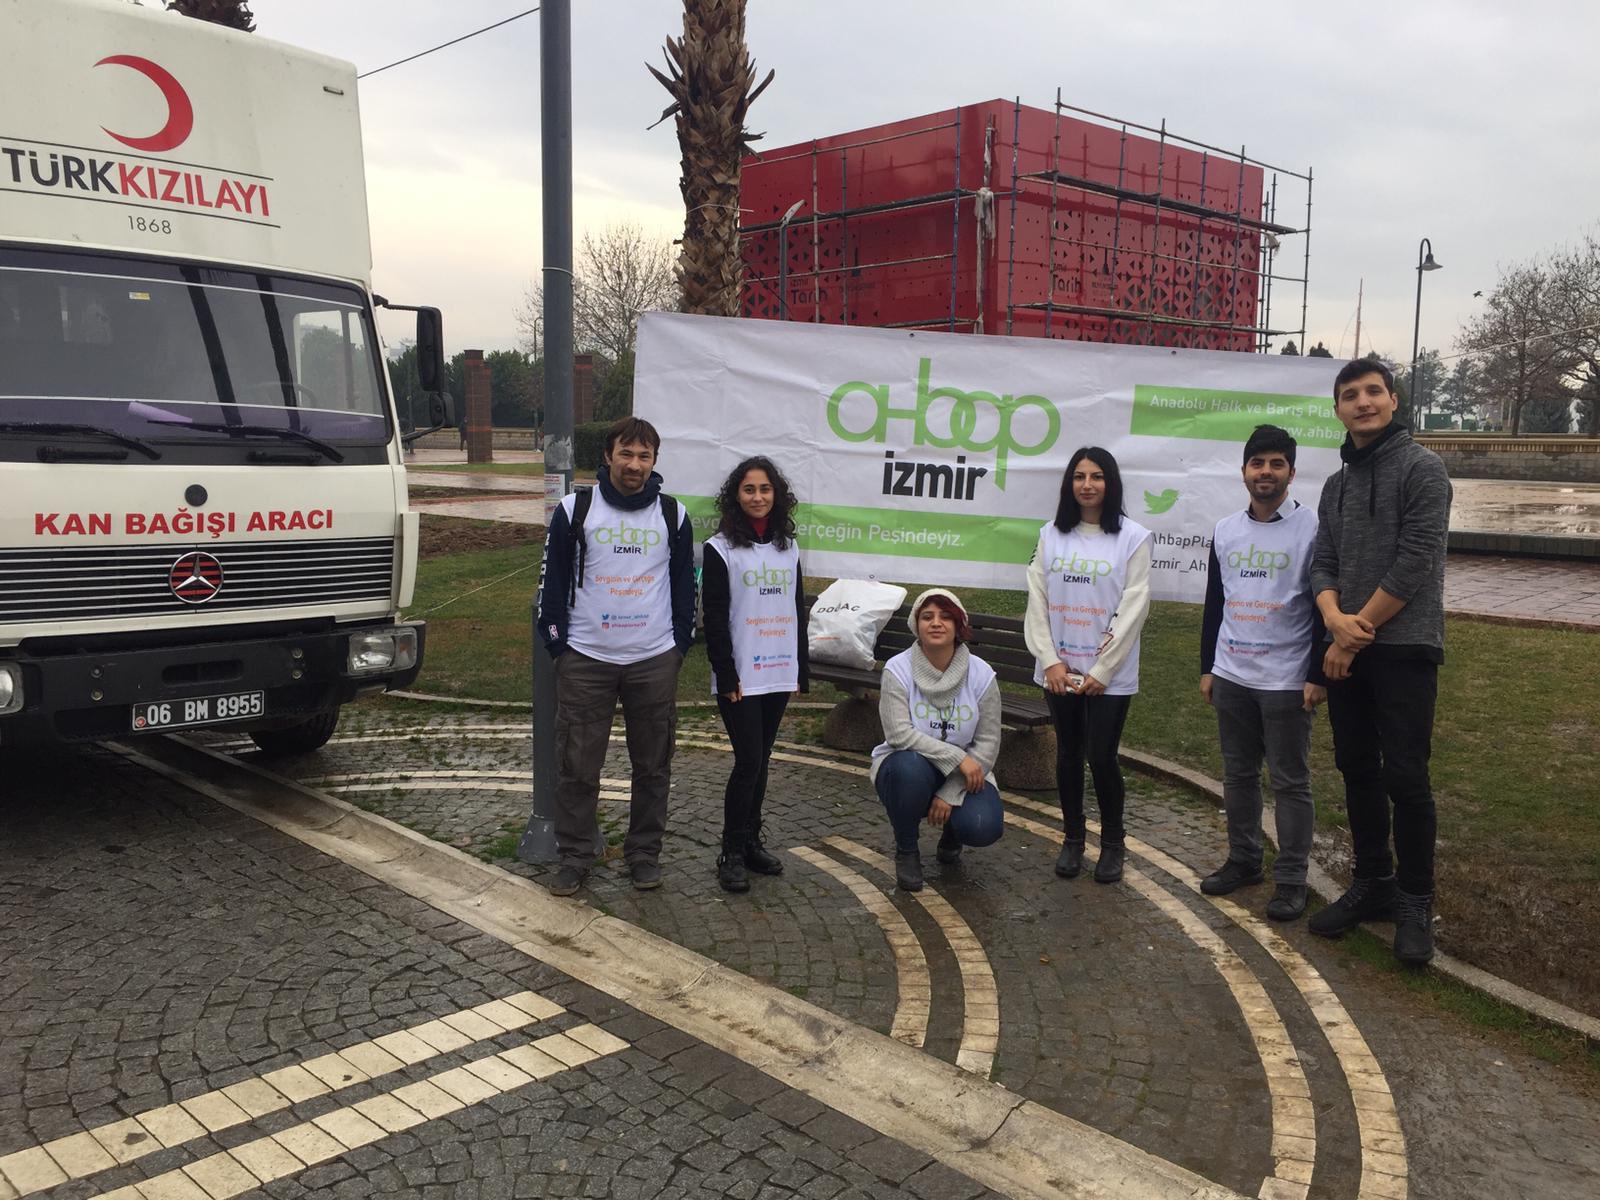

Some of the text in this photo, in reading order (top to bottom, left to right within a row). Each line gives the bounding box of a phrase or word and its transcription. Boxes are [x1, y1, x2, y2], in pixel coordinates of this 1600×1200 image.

[128, 215, 171, 234] 1868
[1150, 394, 1206, 410] Anadolu
[1211, 398, 1241, 413] Halk
[1246, 403, 1262, 414] ve
[882, 450, 988, 500] izmir
[35, 508, 333, 538] KAN BAĞIŞI ARACI
[795, 523, 965, 550] erçeğin Peşindeyiz.
[147, 694, 260, 725] 06 BM 8955
